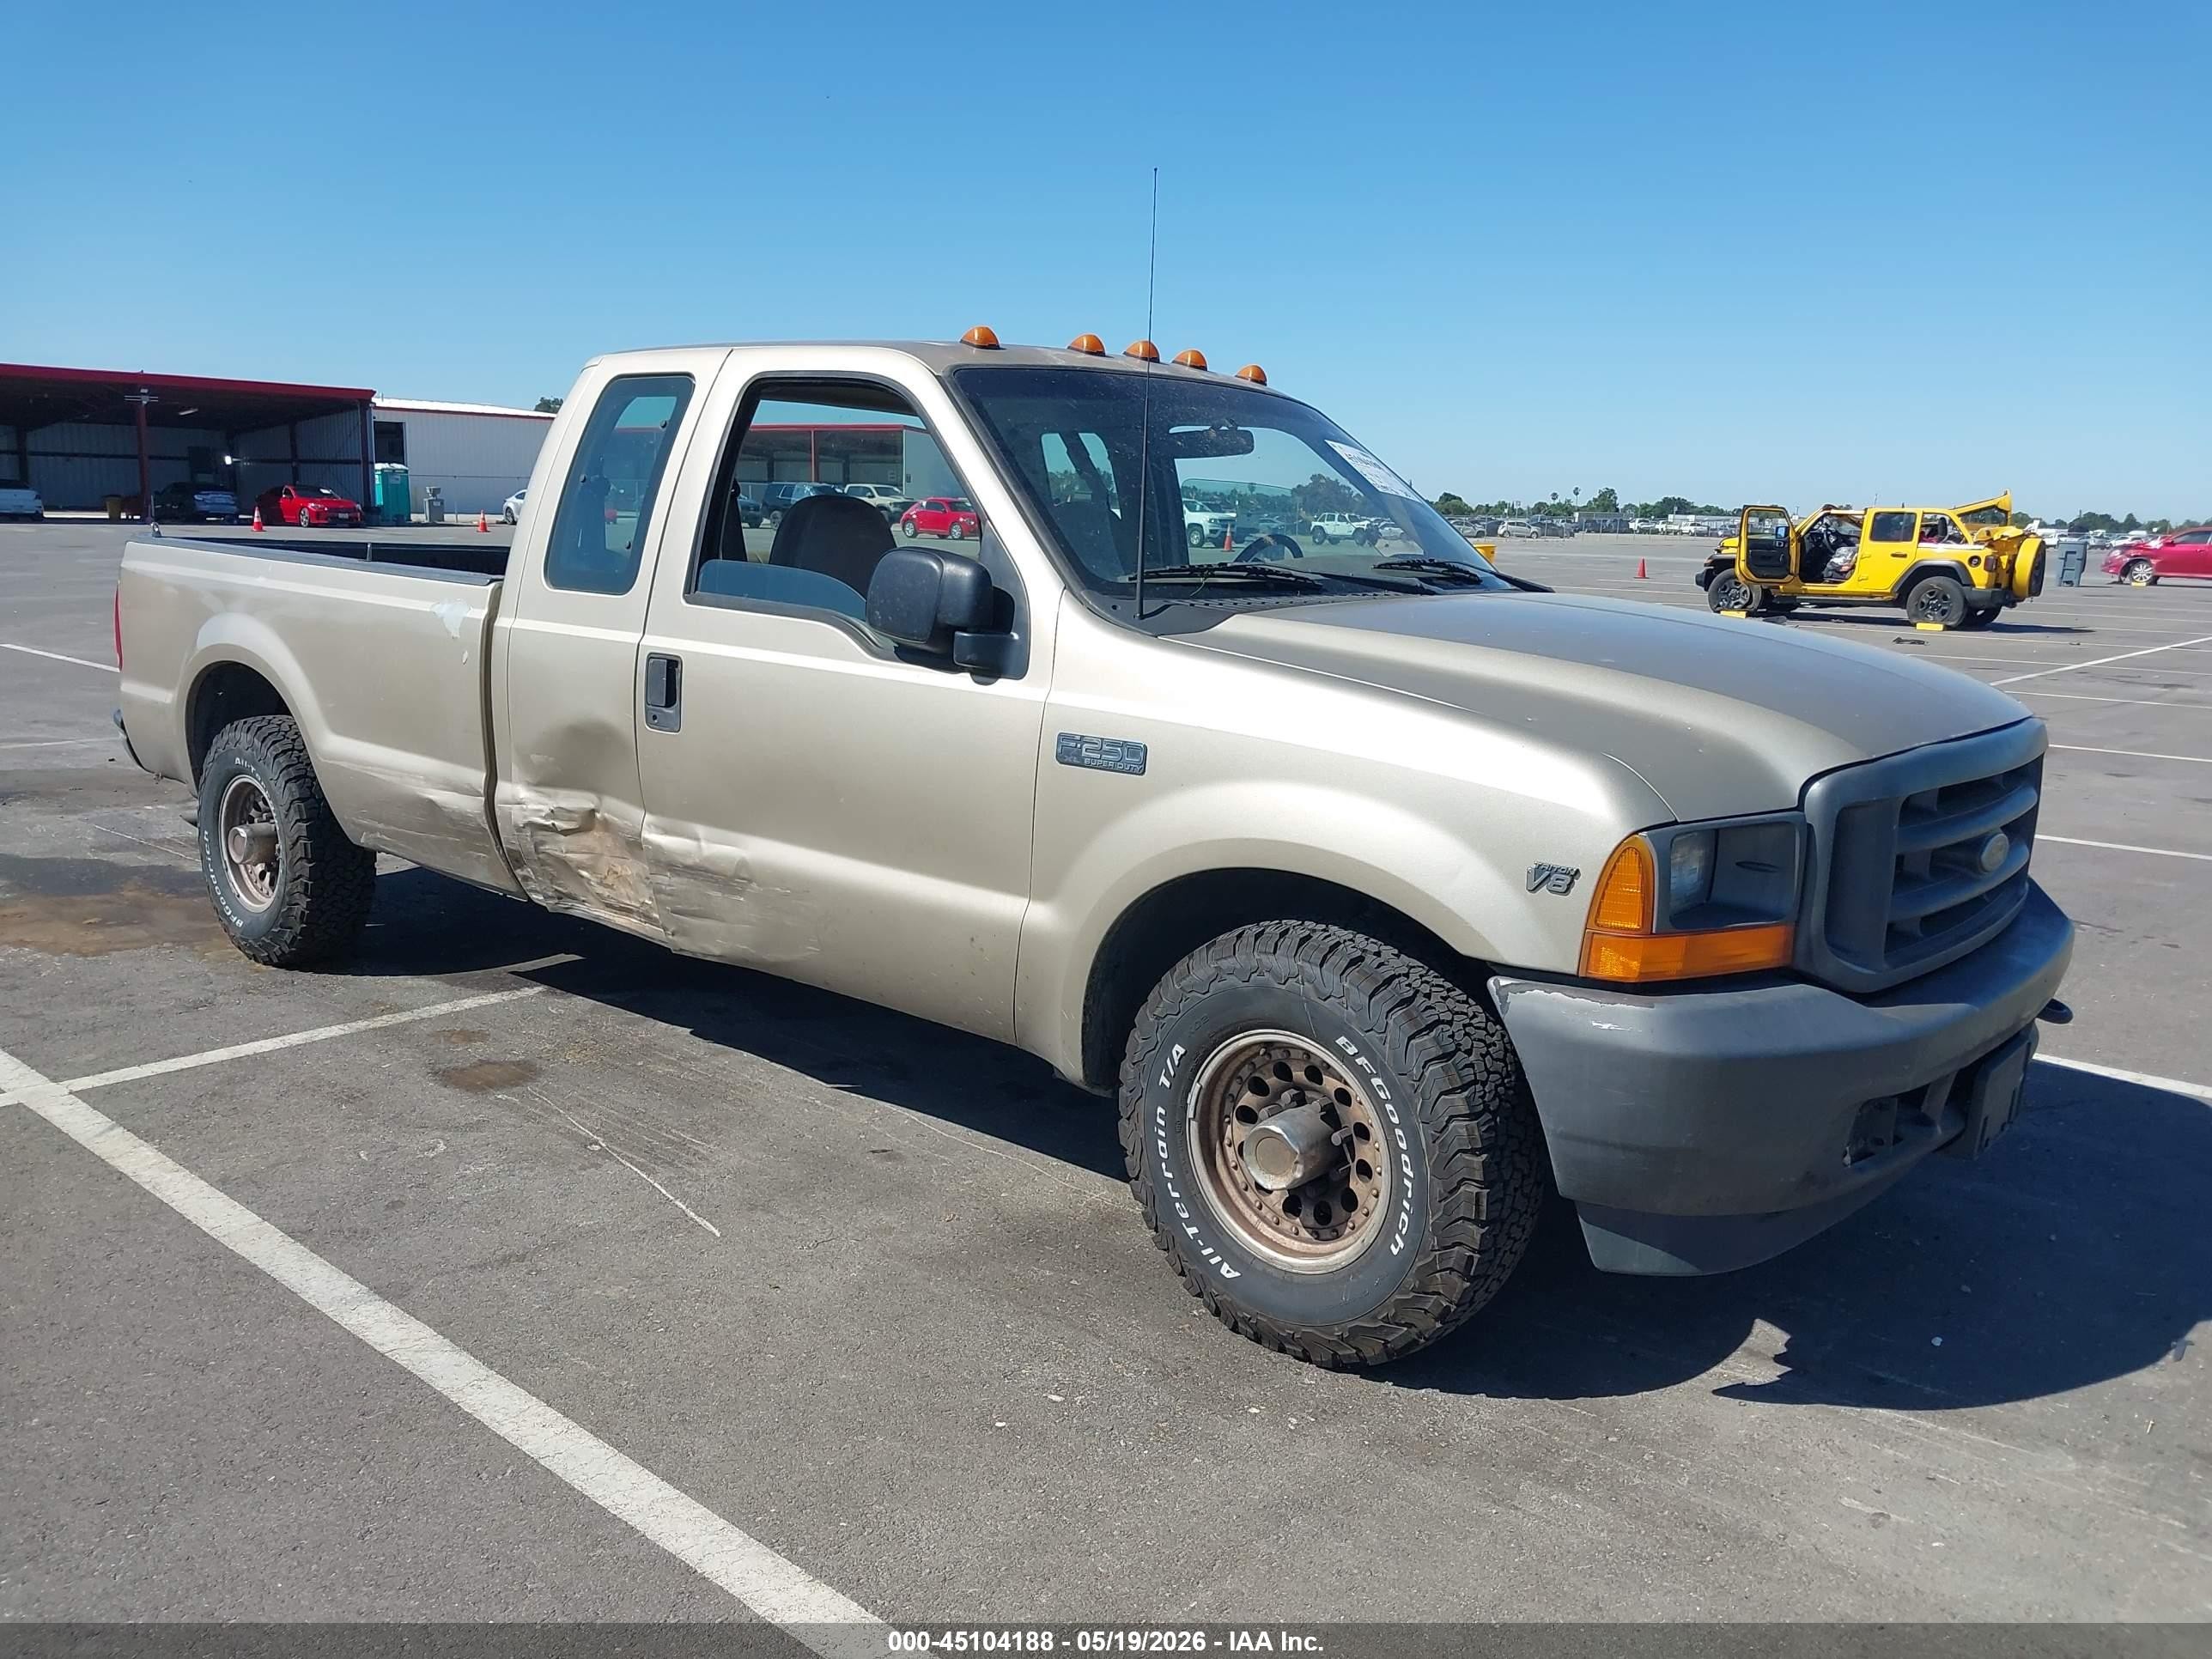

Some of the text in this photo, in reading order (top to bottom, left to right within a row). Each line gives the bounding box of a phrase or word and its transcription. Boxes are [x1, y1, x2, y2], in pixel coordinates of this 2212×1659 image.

[1084, 757, 1144, 774] SUPER DUTY
[1526, 867, 1573, 895] V8
[1534, 860, 1577, 876] TRITON
[1158, 1043, 1187, 1090] T/A
[1334, 1035, 1415, 1256] BFGoodrich
[1154, 1105, 1242, 1279] All-Terrain
